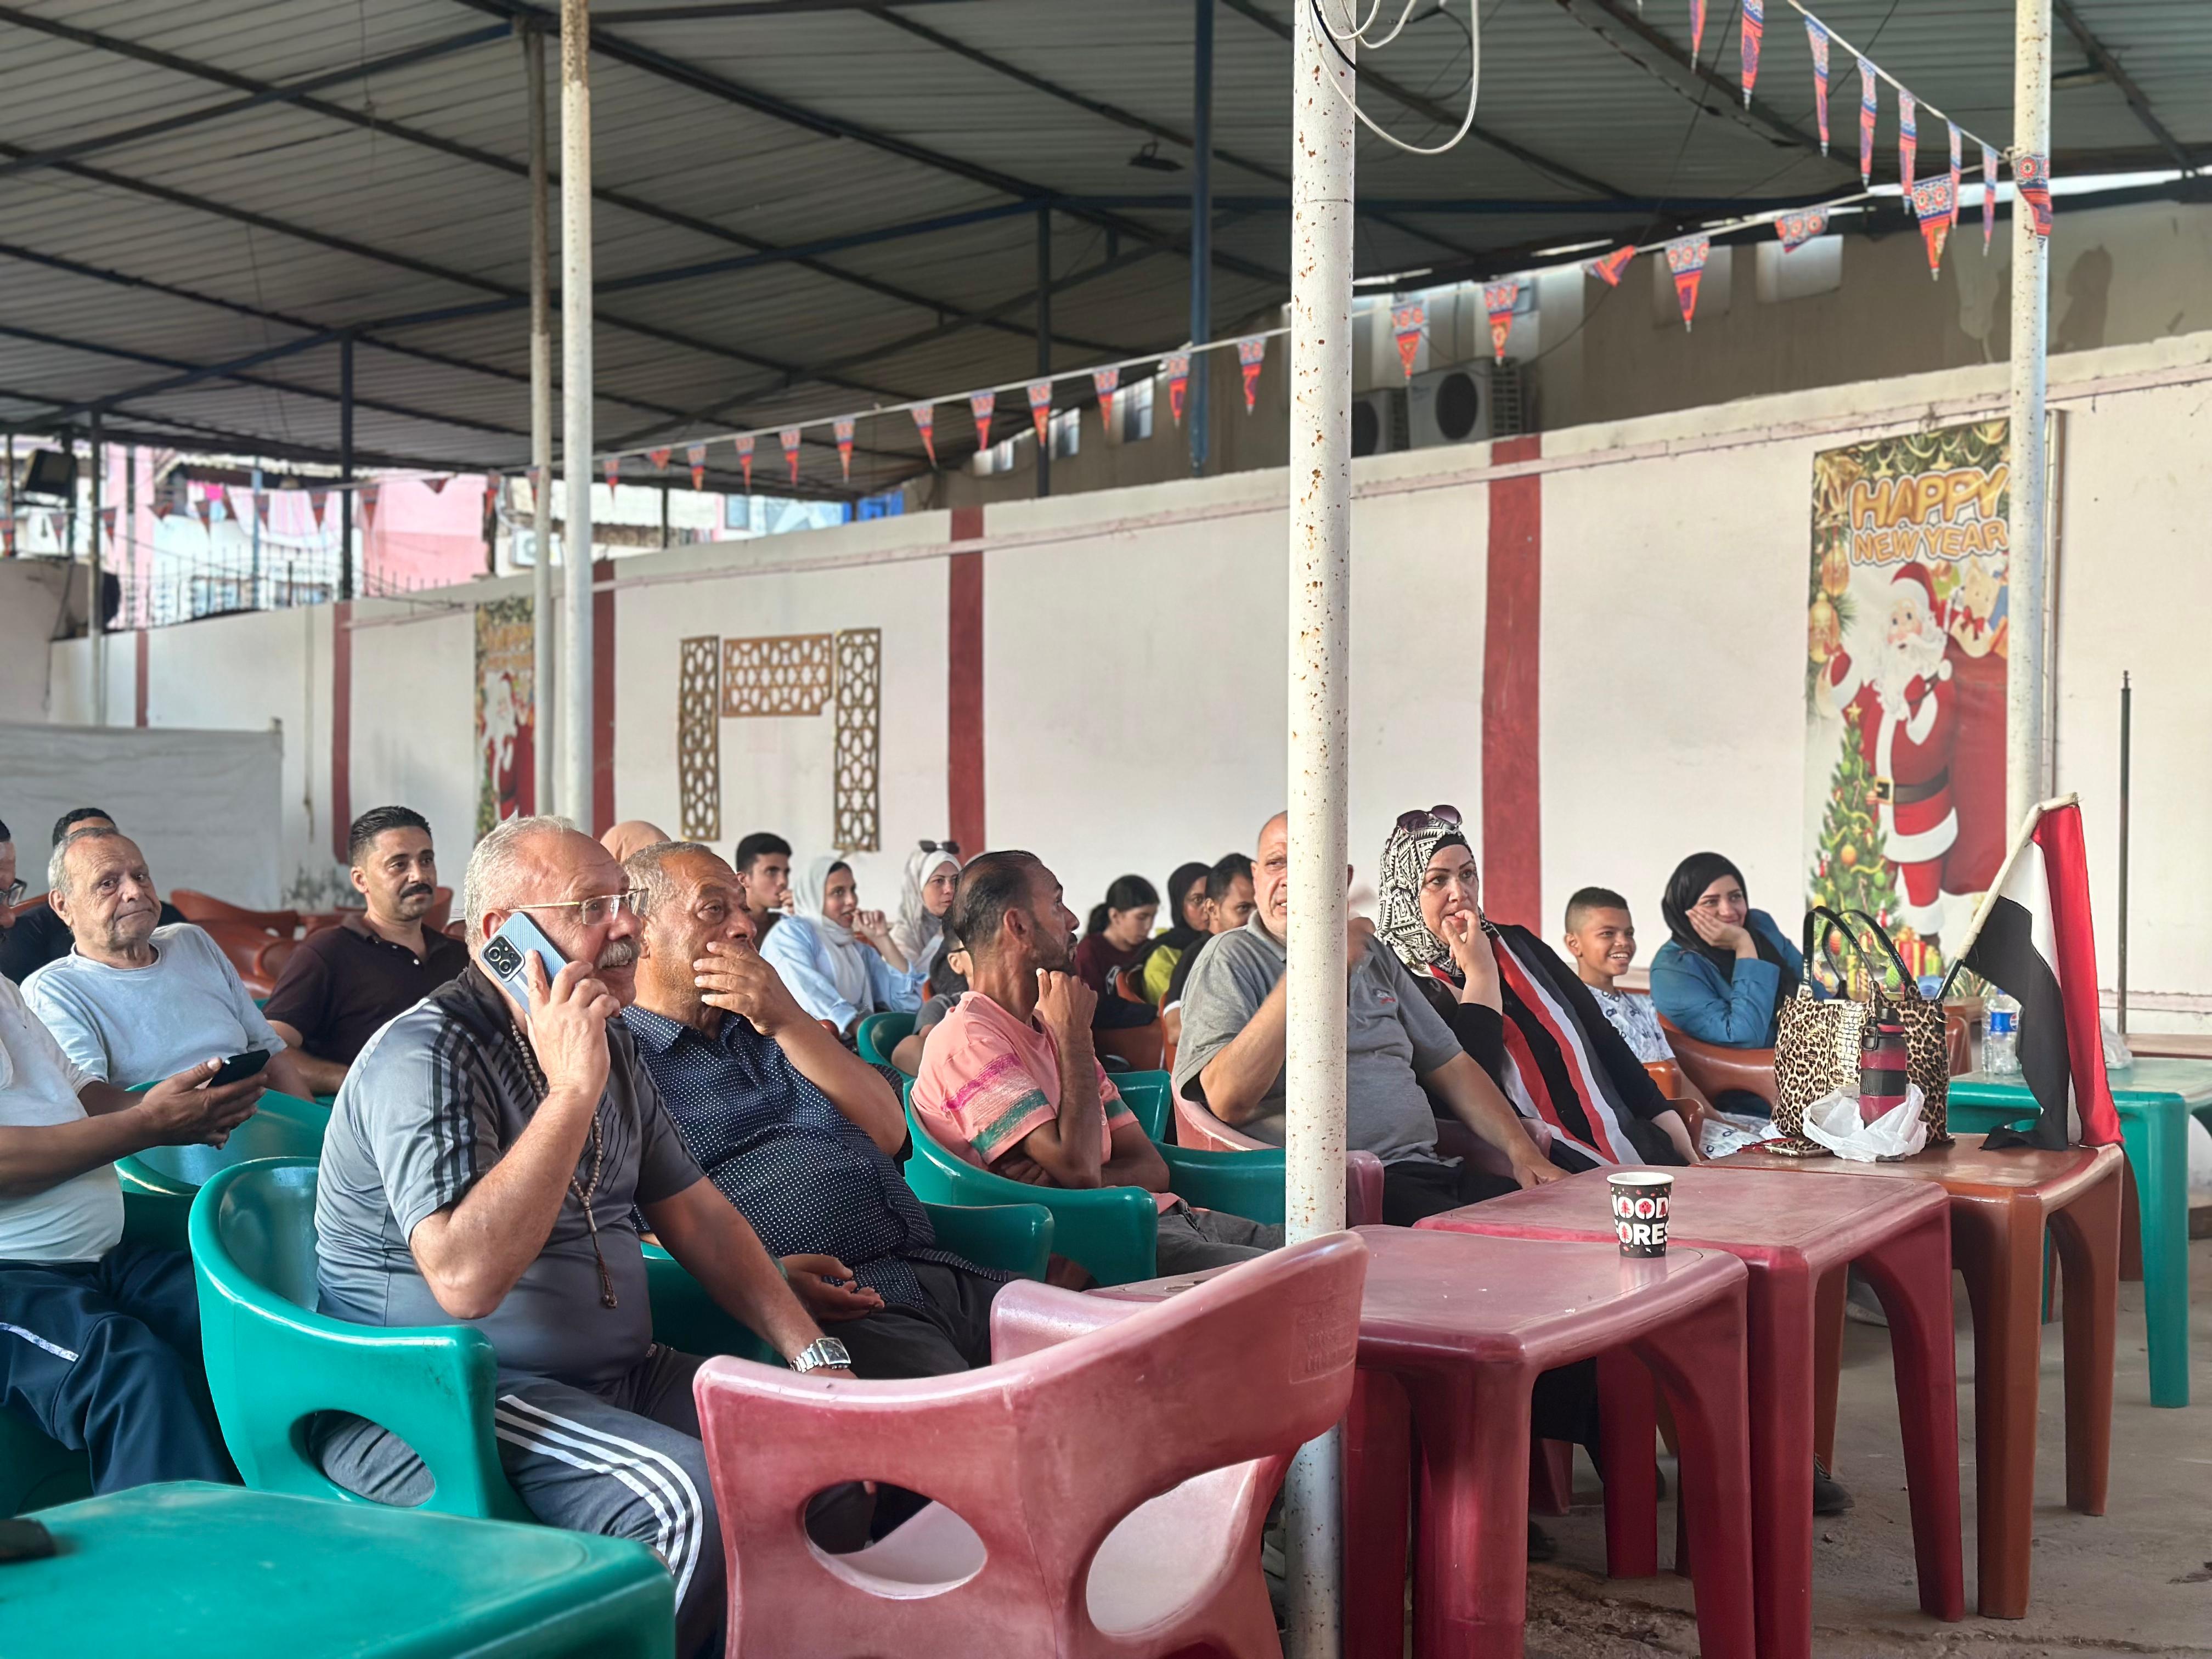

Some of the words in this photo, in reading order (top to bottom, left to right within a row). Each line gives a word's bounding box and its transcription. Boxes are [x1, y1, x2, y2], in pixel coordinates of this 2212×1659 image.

[1852, 464, 2009, 530] HAPPY
[1853, 530, 1919, 562] NEW
[1923, 520, 2008, 556] YEAR
[1611, 1194, 1671, 1219] OOD
[1615, 1219, 1668, 1245] ORE
